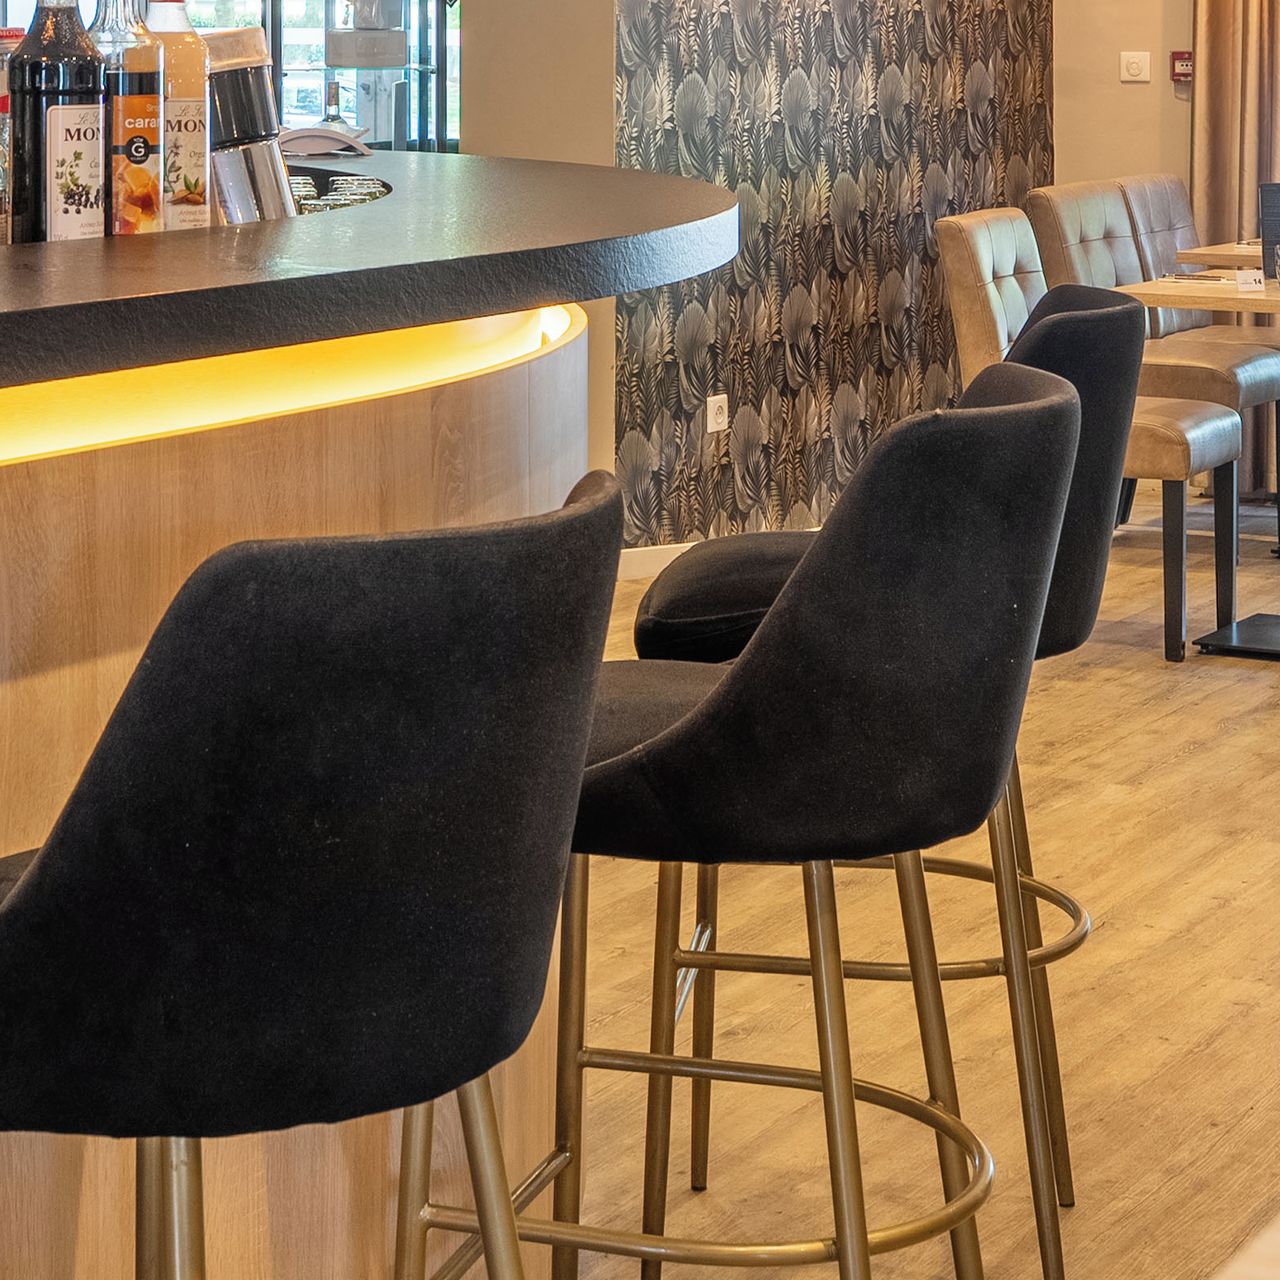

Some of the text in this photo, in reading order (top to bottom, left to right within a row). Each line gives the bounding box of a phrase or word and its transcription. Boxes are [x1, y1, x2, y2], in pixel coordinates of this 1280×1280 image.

[124, 117, 160, 129] cara
[165, 119, 206, 133] MON
[64, 127, 101, 142] MON
[1253, 278, 1263, 286] 14
